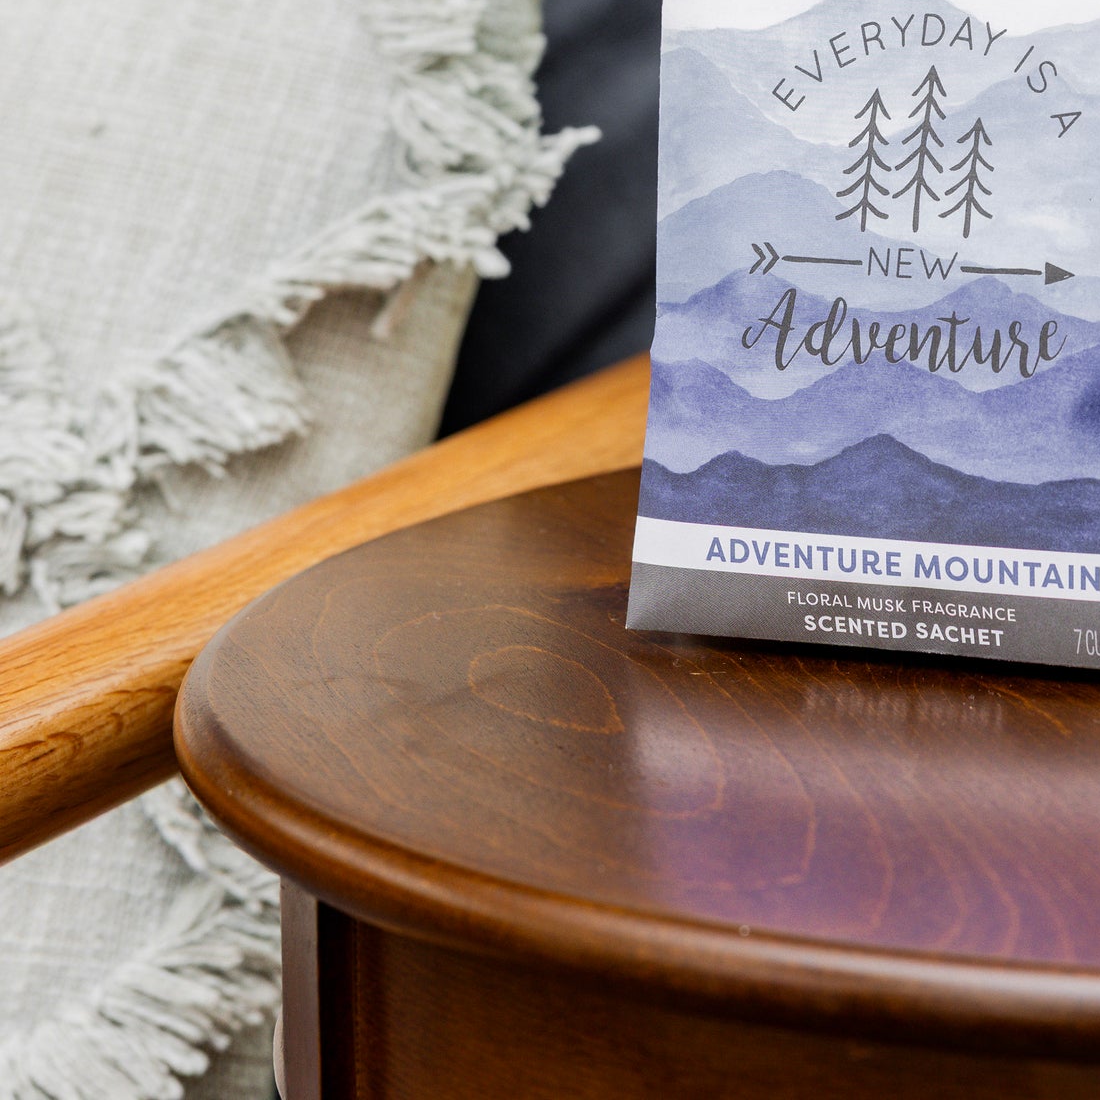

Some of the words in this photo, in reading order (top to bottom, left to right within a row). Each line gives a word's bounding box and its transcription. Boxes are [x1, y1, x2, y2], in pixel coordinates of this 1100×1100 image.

[771, 13, 1007, 112] EVERYDAY
[1014, 45, 1058, 94] IS
[1050, 110, 1083, 138] A
[869, 246, 959, 281] NEW
[741, 288, 1068, 378] Adventure
[705, 537, 901, 577] ADVENTURE
[913, 554, 1100, 592] MOUNTAIN
[787, 591, 853, 609] FLORAL
[857, 596, 906, 613] MUSK
[912, 600, 1017, 622] FRAGRANCE
[804, 615, 907, 640] SCENTED
[916, 622, 1004, 647] SACHET
[1073, 629, 1082, 655] 7
